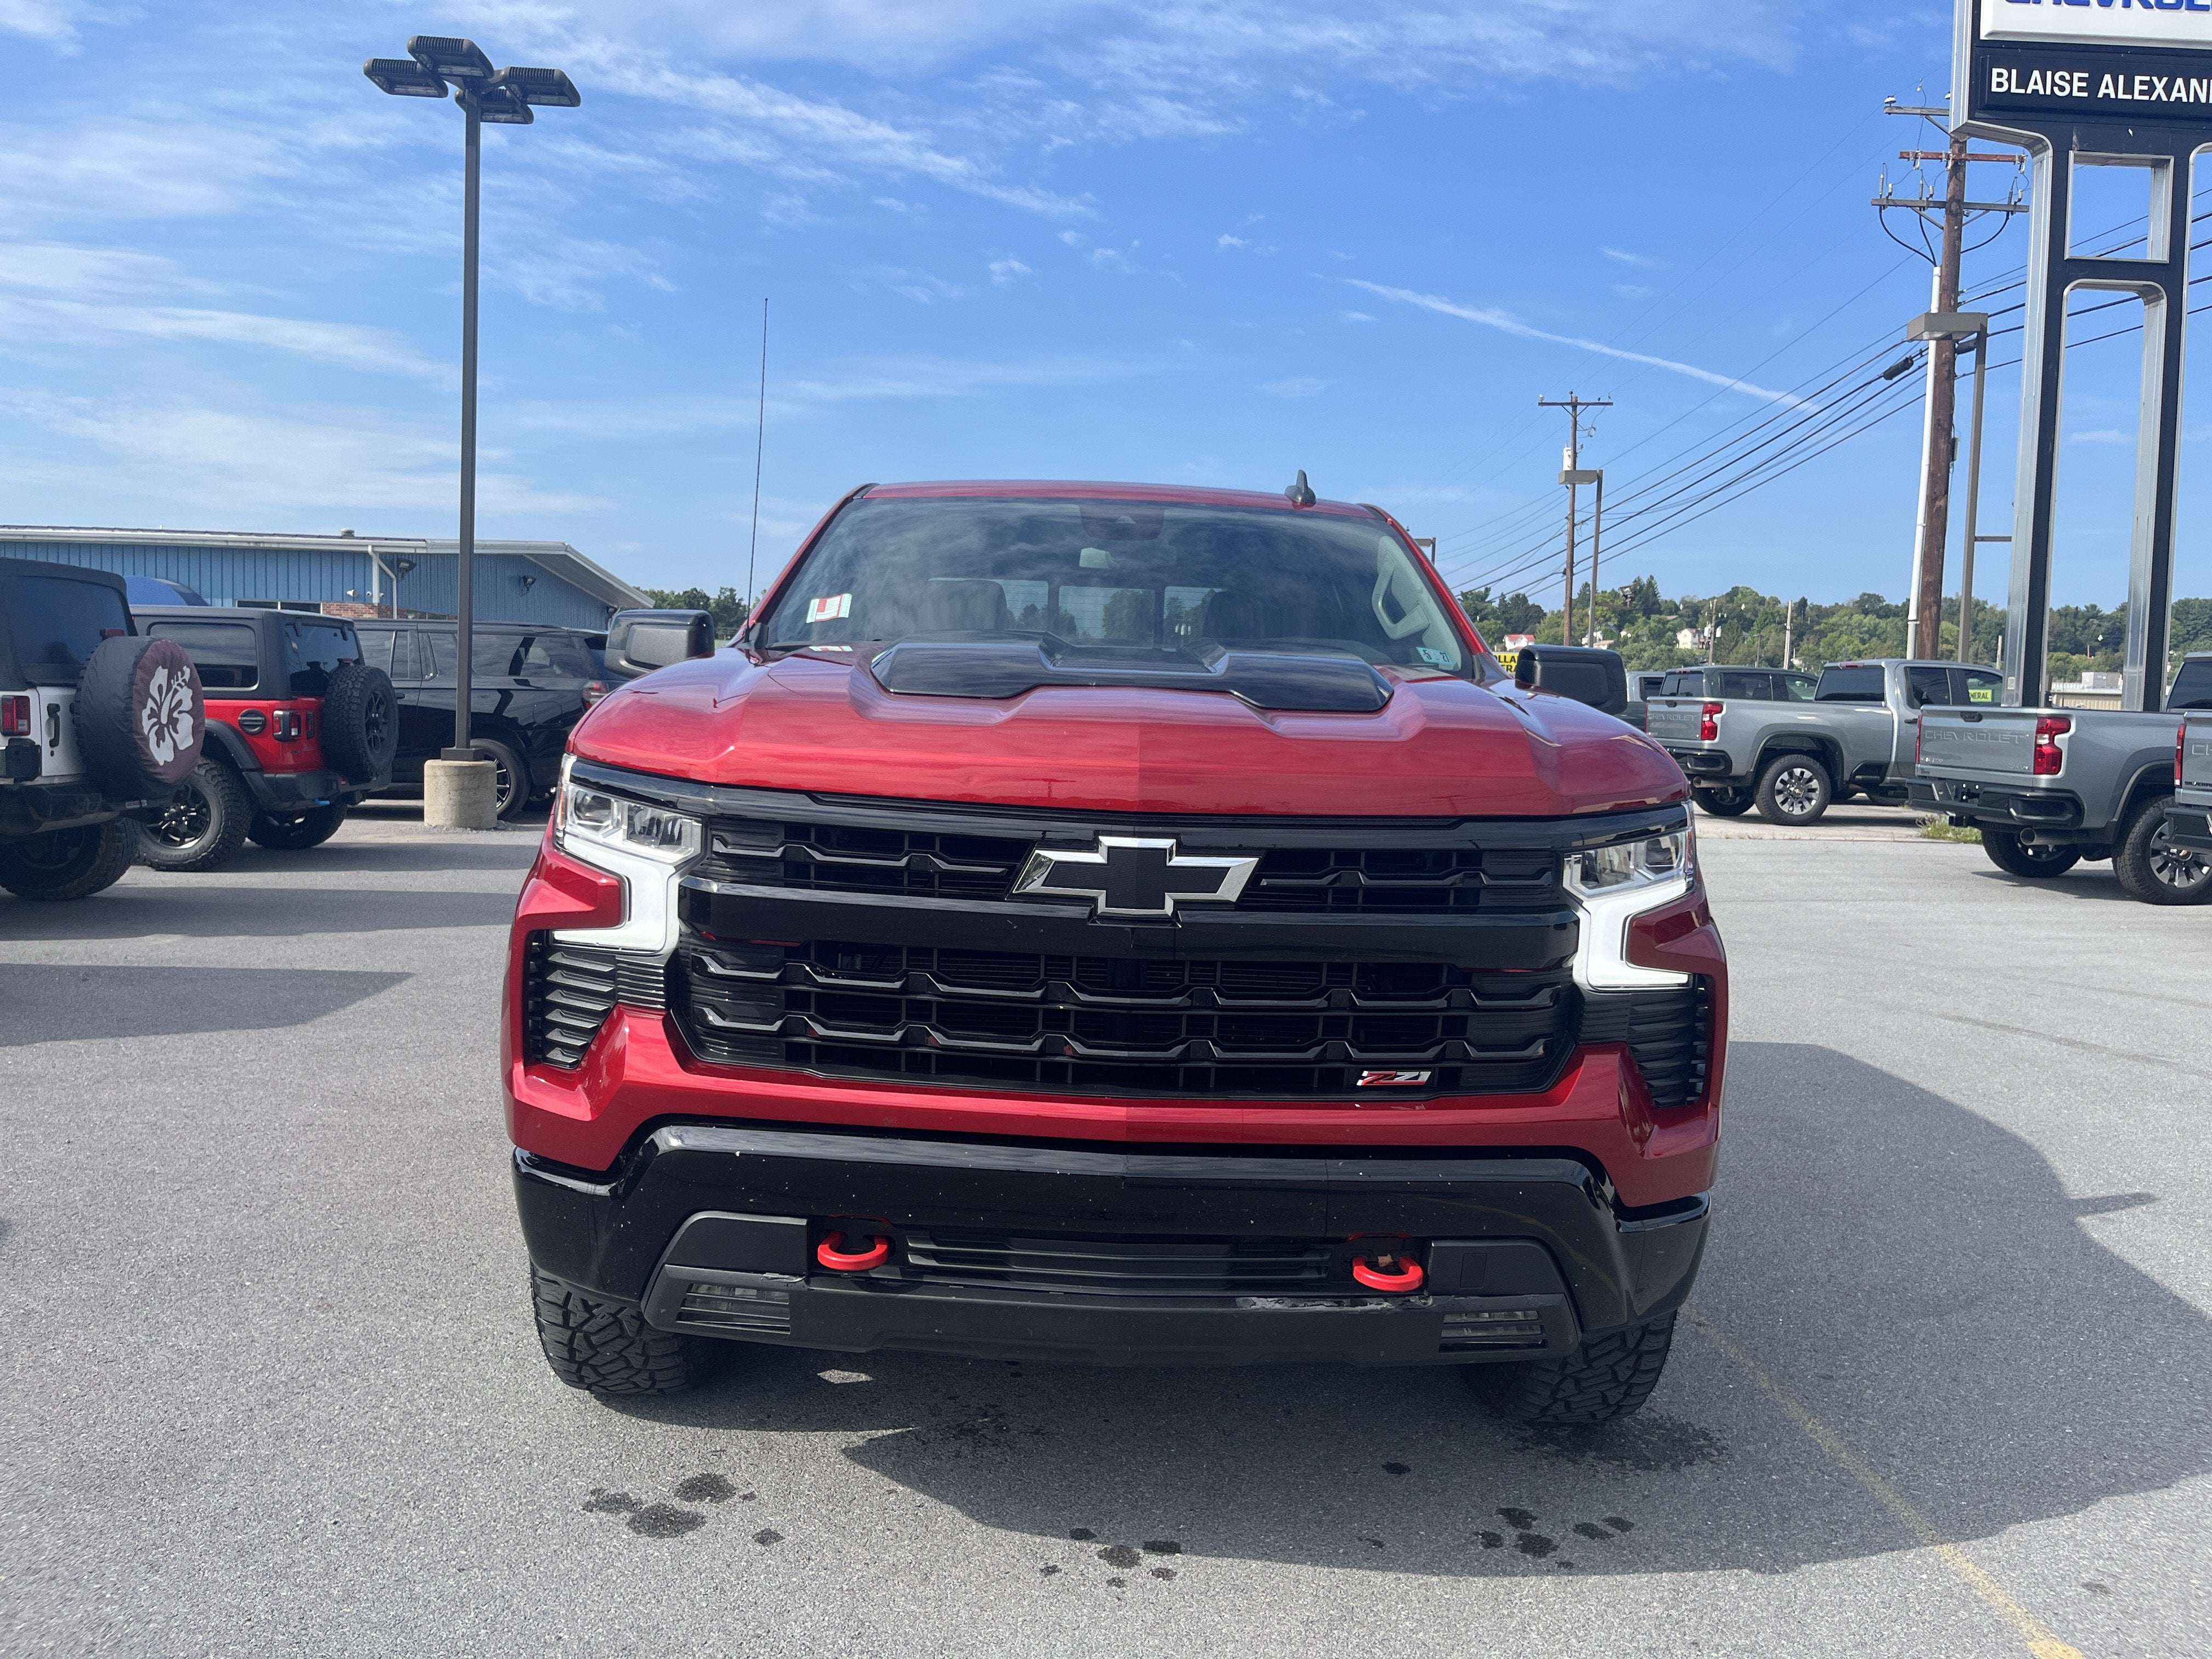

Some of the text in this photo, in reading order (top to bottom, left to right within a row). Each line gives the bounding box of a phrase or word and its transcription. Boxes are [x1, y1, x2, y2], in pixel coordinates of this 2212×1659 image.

[1991, 67, 2212, 104] BLAISE ALEXAN
[1925, 730, 2027, 744] CHEVROLET
[1356, 1070, 1431, 1086] Z71
